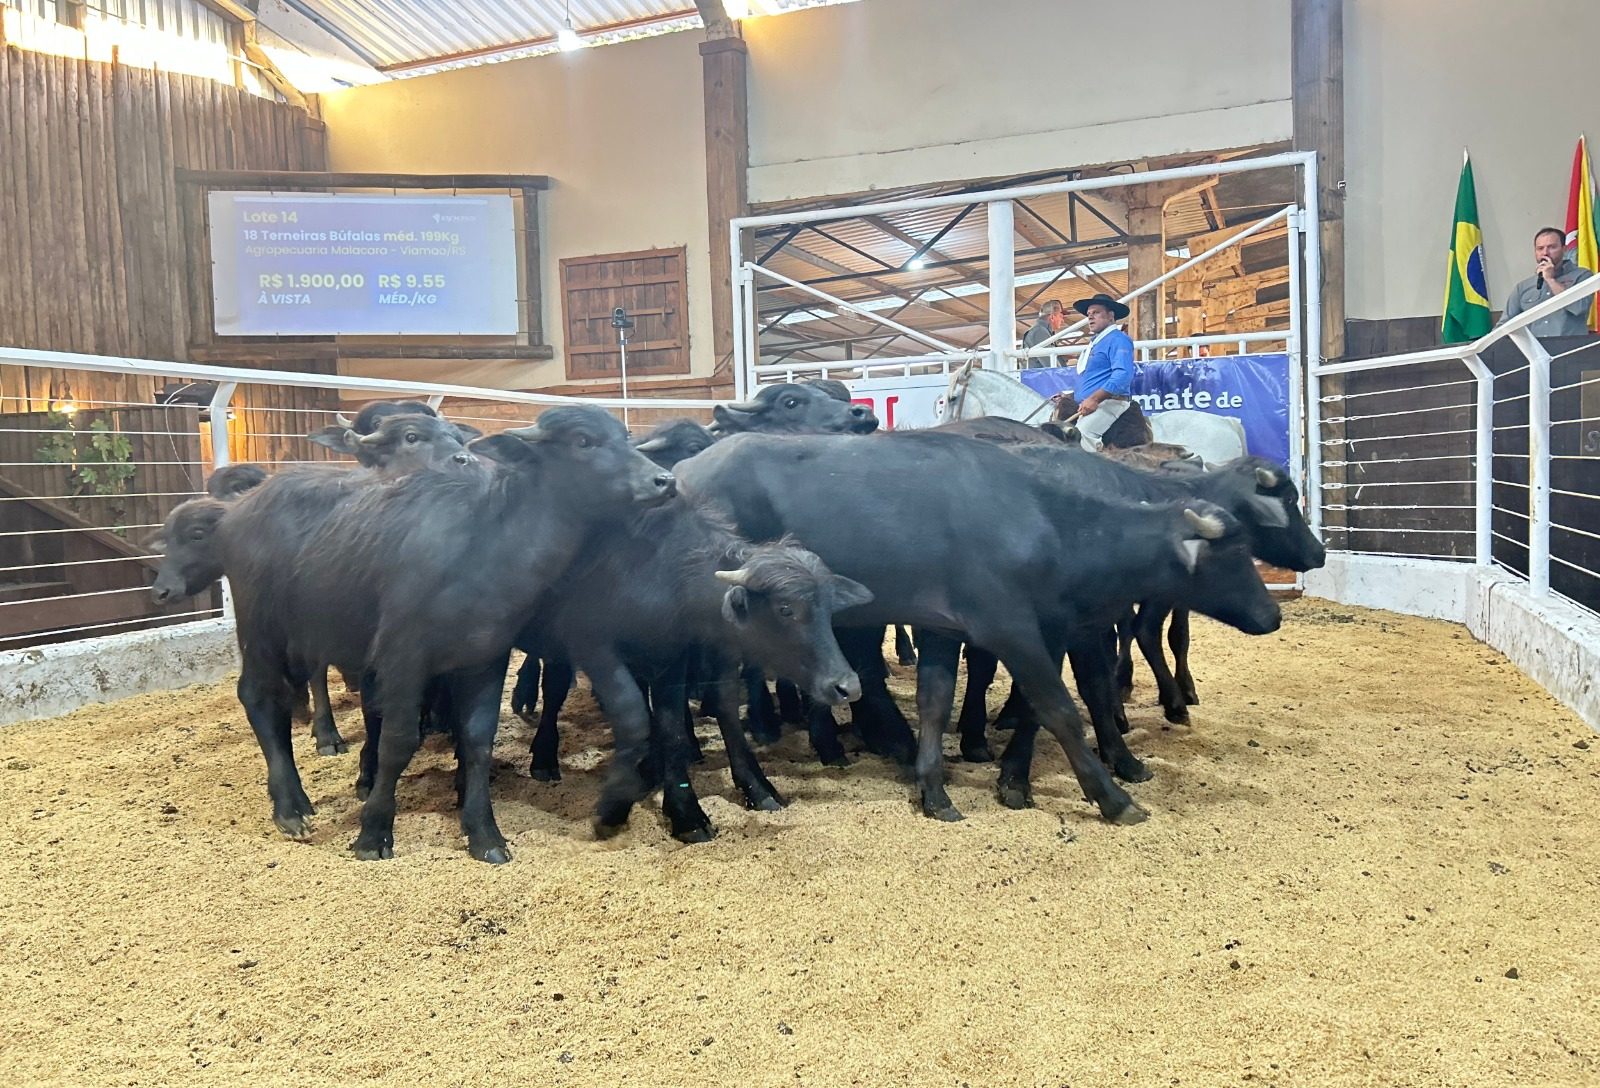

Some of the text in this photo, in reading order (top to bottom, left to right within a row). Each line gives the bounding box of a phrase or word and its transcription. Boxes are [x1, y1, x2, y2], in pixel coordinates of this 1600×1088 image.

[243, 211, 298, 223] Lote 14
[243, 229, 460, 245] 18 Terneiras Búfalas méd. 199Kg
[259, 273, 365, 290] R$ 1.900,00
[378, 274, 446, 289] R$ 9.55
[257, 291, 312, 305] À VISTA
[378, 291, 437, 307] MÉD./KG
[1216, 392, 1243, 408] de
